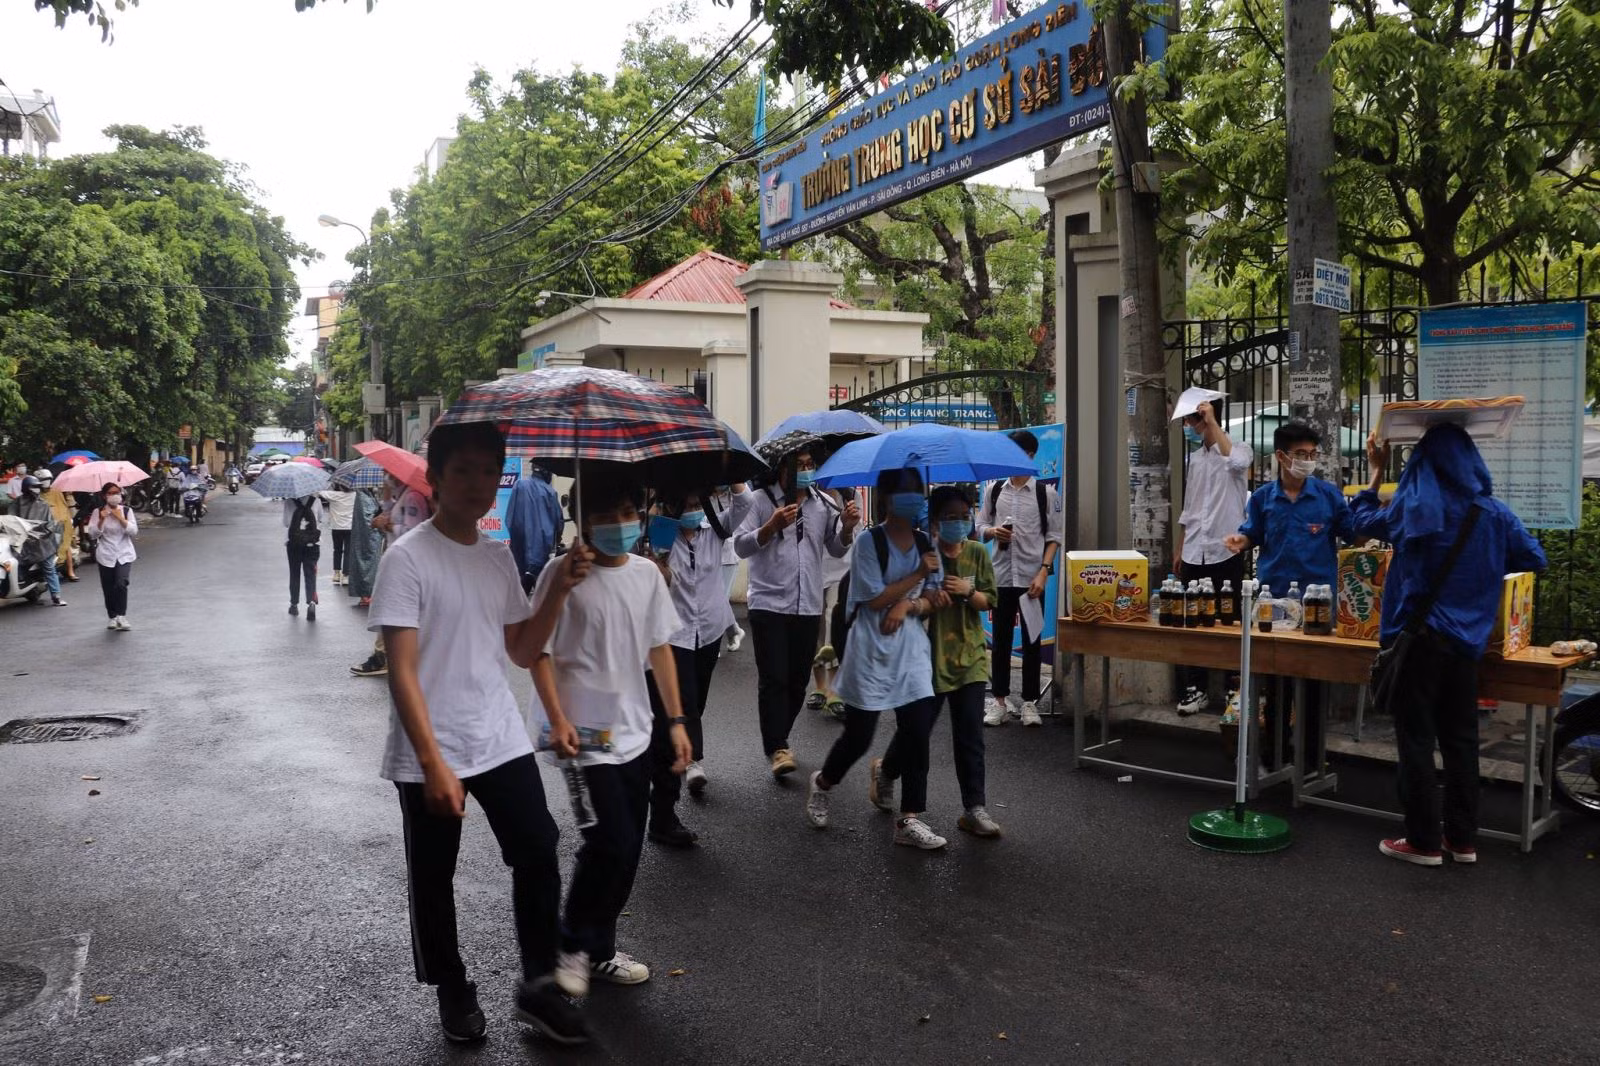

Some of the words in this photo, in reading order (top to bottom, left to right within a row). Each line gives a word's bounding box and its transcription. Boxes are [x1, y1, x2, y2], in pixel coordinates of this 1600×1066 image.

[896, 82, 911, 105] VÀ
[913, 72, 936, 98] ĐÀO
[941, 62, 961, 86] TẠO
[965, 42, 1001, 71] QUẬN
[1004, 21, 1041, 53] LONG
[1045, 2, 1077, 32] BIÊN
[800, 151, 850, 210] TRƯỜNG
[854, 128, 903, 186] TRUNG
[907, 108, 944, 164] HỌC
[949, 87, 977, 145] CƠ
[983, 55, 1013, 130] SỞ
[1019, 47, 1060, 114] SÀI
[931, 166, 945, 180] BIÊN
[949, 159, 960, 174] HÀ
[960, 154, 972, 170] NỘI
[1316, 267, 1334, 282] DIỆT
[910, 408, 949, 418] KHANG
[952, 408, 992, 418] TRANG
[1343, 572, 1371, 623] MIRINDA
